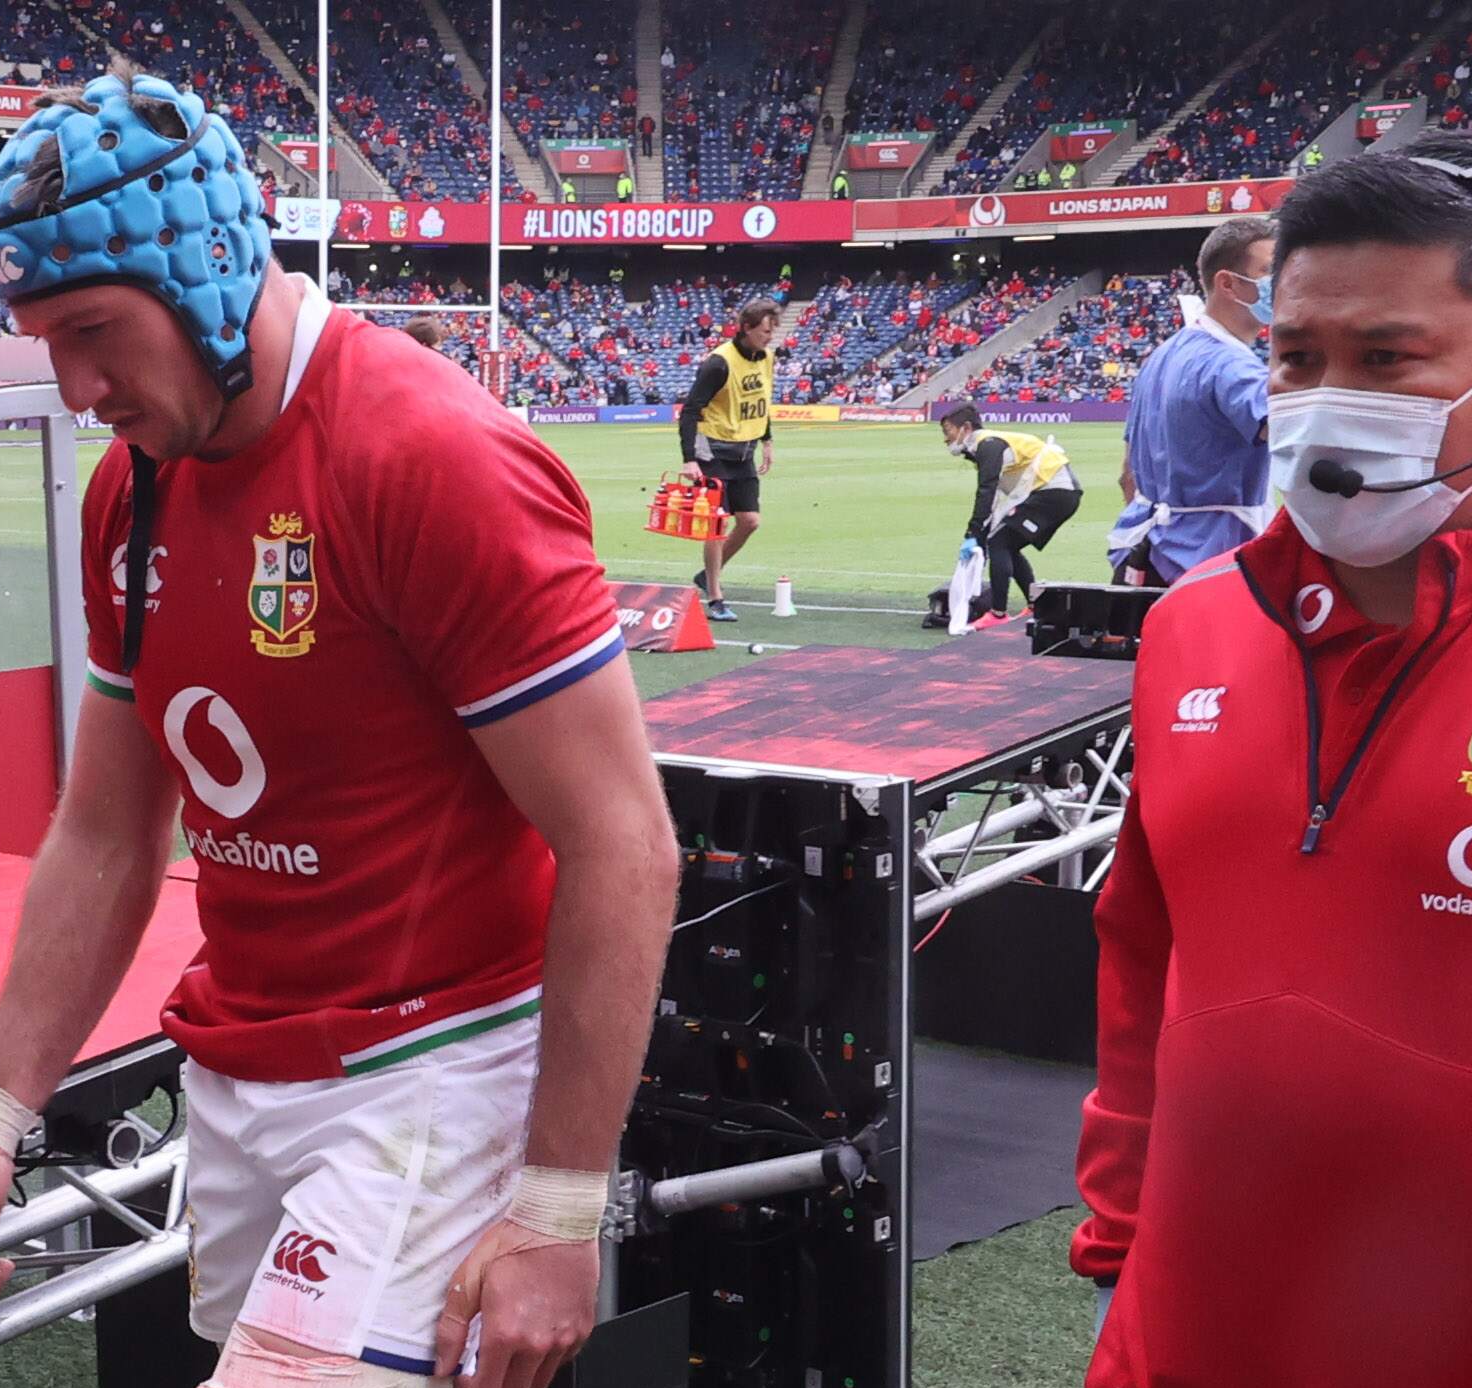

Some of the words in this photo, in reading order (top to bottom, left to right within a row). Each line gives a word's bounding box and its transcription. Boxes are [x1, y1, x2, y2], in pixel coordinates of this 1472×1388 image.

[1049, 199, 1098, 215] LIONS
[1111, 196, 1167, 212] JAPAN
[524, 208, 714, 239] #LIONS1888CUP
[740, 398, 766, 421] H2O
[979, 413, 1010, 423] OYAL
[1016, 412, 1072, 423] LONDON
[262, 1271, 325, 1302] canterbury
